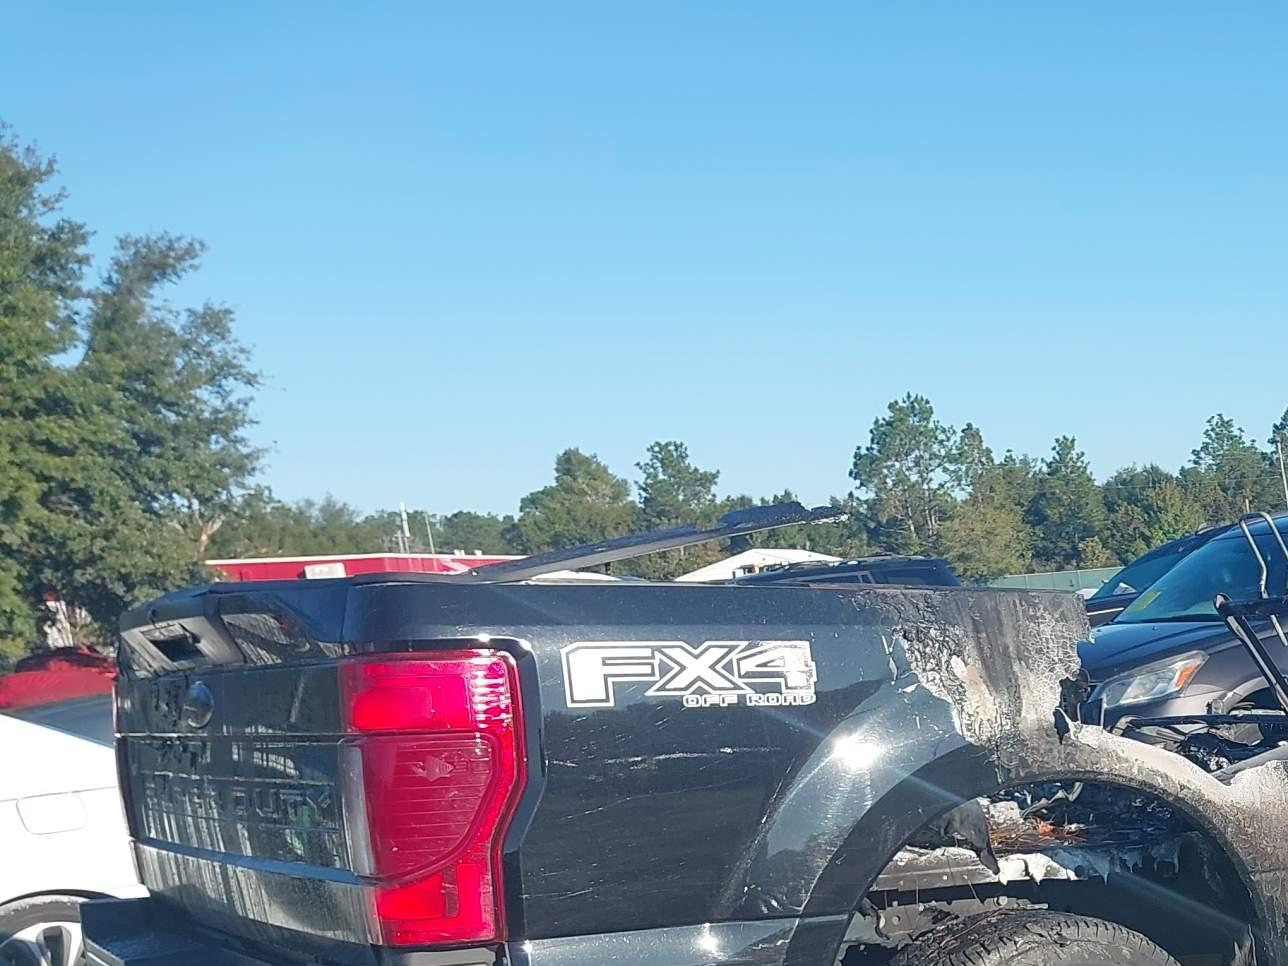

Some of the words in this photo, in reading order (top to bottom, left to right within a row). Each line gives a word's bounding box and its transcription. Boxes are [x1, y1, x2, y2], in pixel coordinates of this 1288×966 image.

[560, 640, 817, 708] FX4
[682, 693, 739, 708] OFF
[746, 692, 817, 707] ROAD
